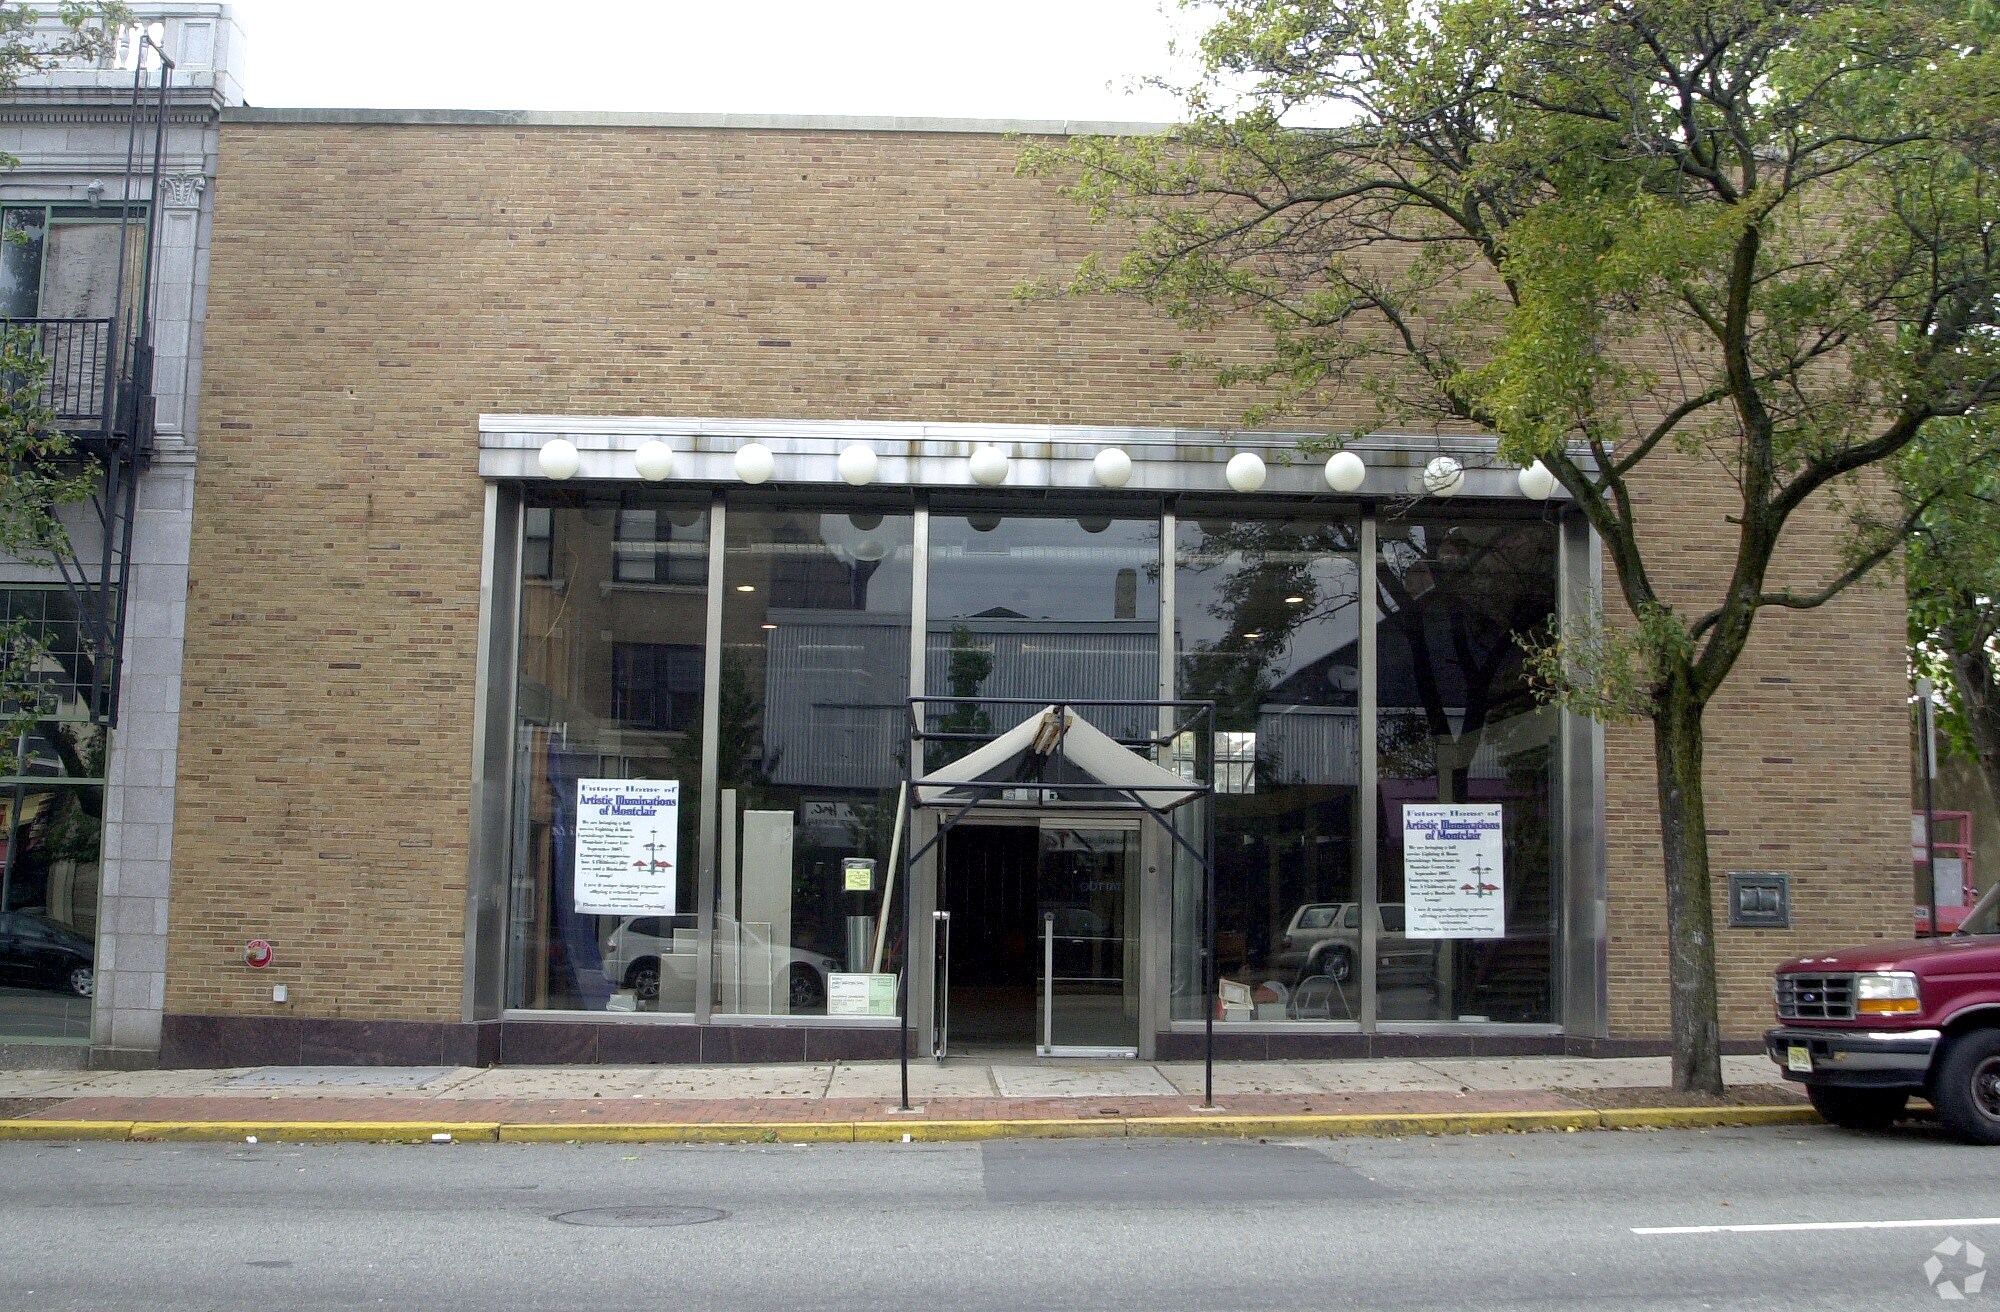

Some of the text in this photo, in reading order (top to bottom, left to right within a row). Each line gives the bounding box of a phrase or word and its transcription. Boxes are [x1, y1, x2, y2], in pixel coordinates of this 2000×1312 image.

[625, 785, 660, 793] Home
[580, 793, 677, 806] Artistic Illuminations
[599, 805, 657, 817] of Montclair
[1487, 809, 1501, 817] of
[1405, 819, 1439, 830] Artistic
[1425, 829, 1482, 840] of Montclair
